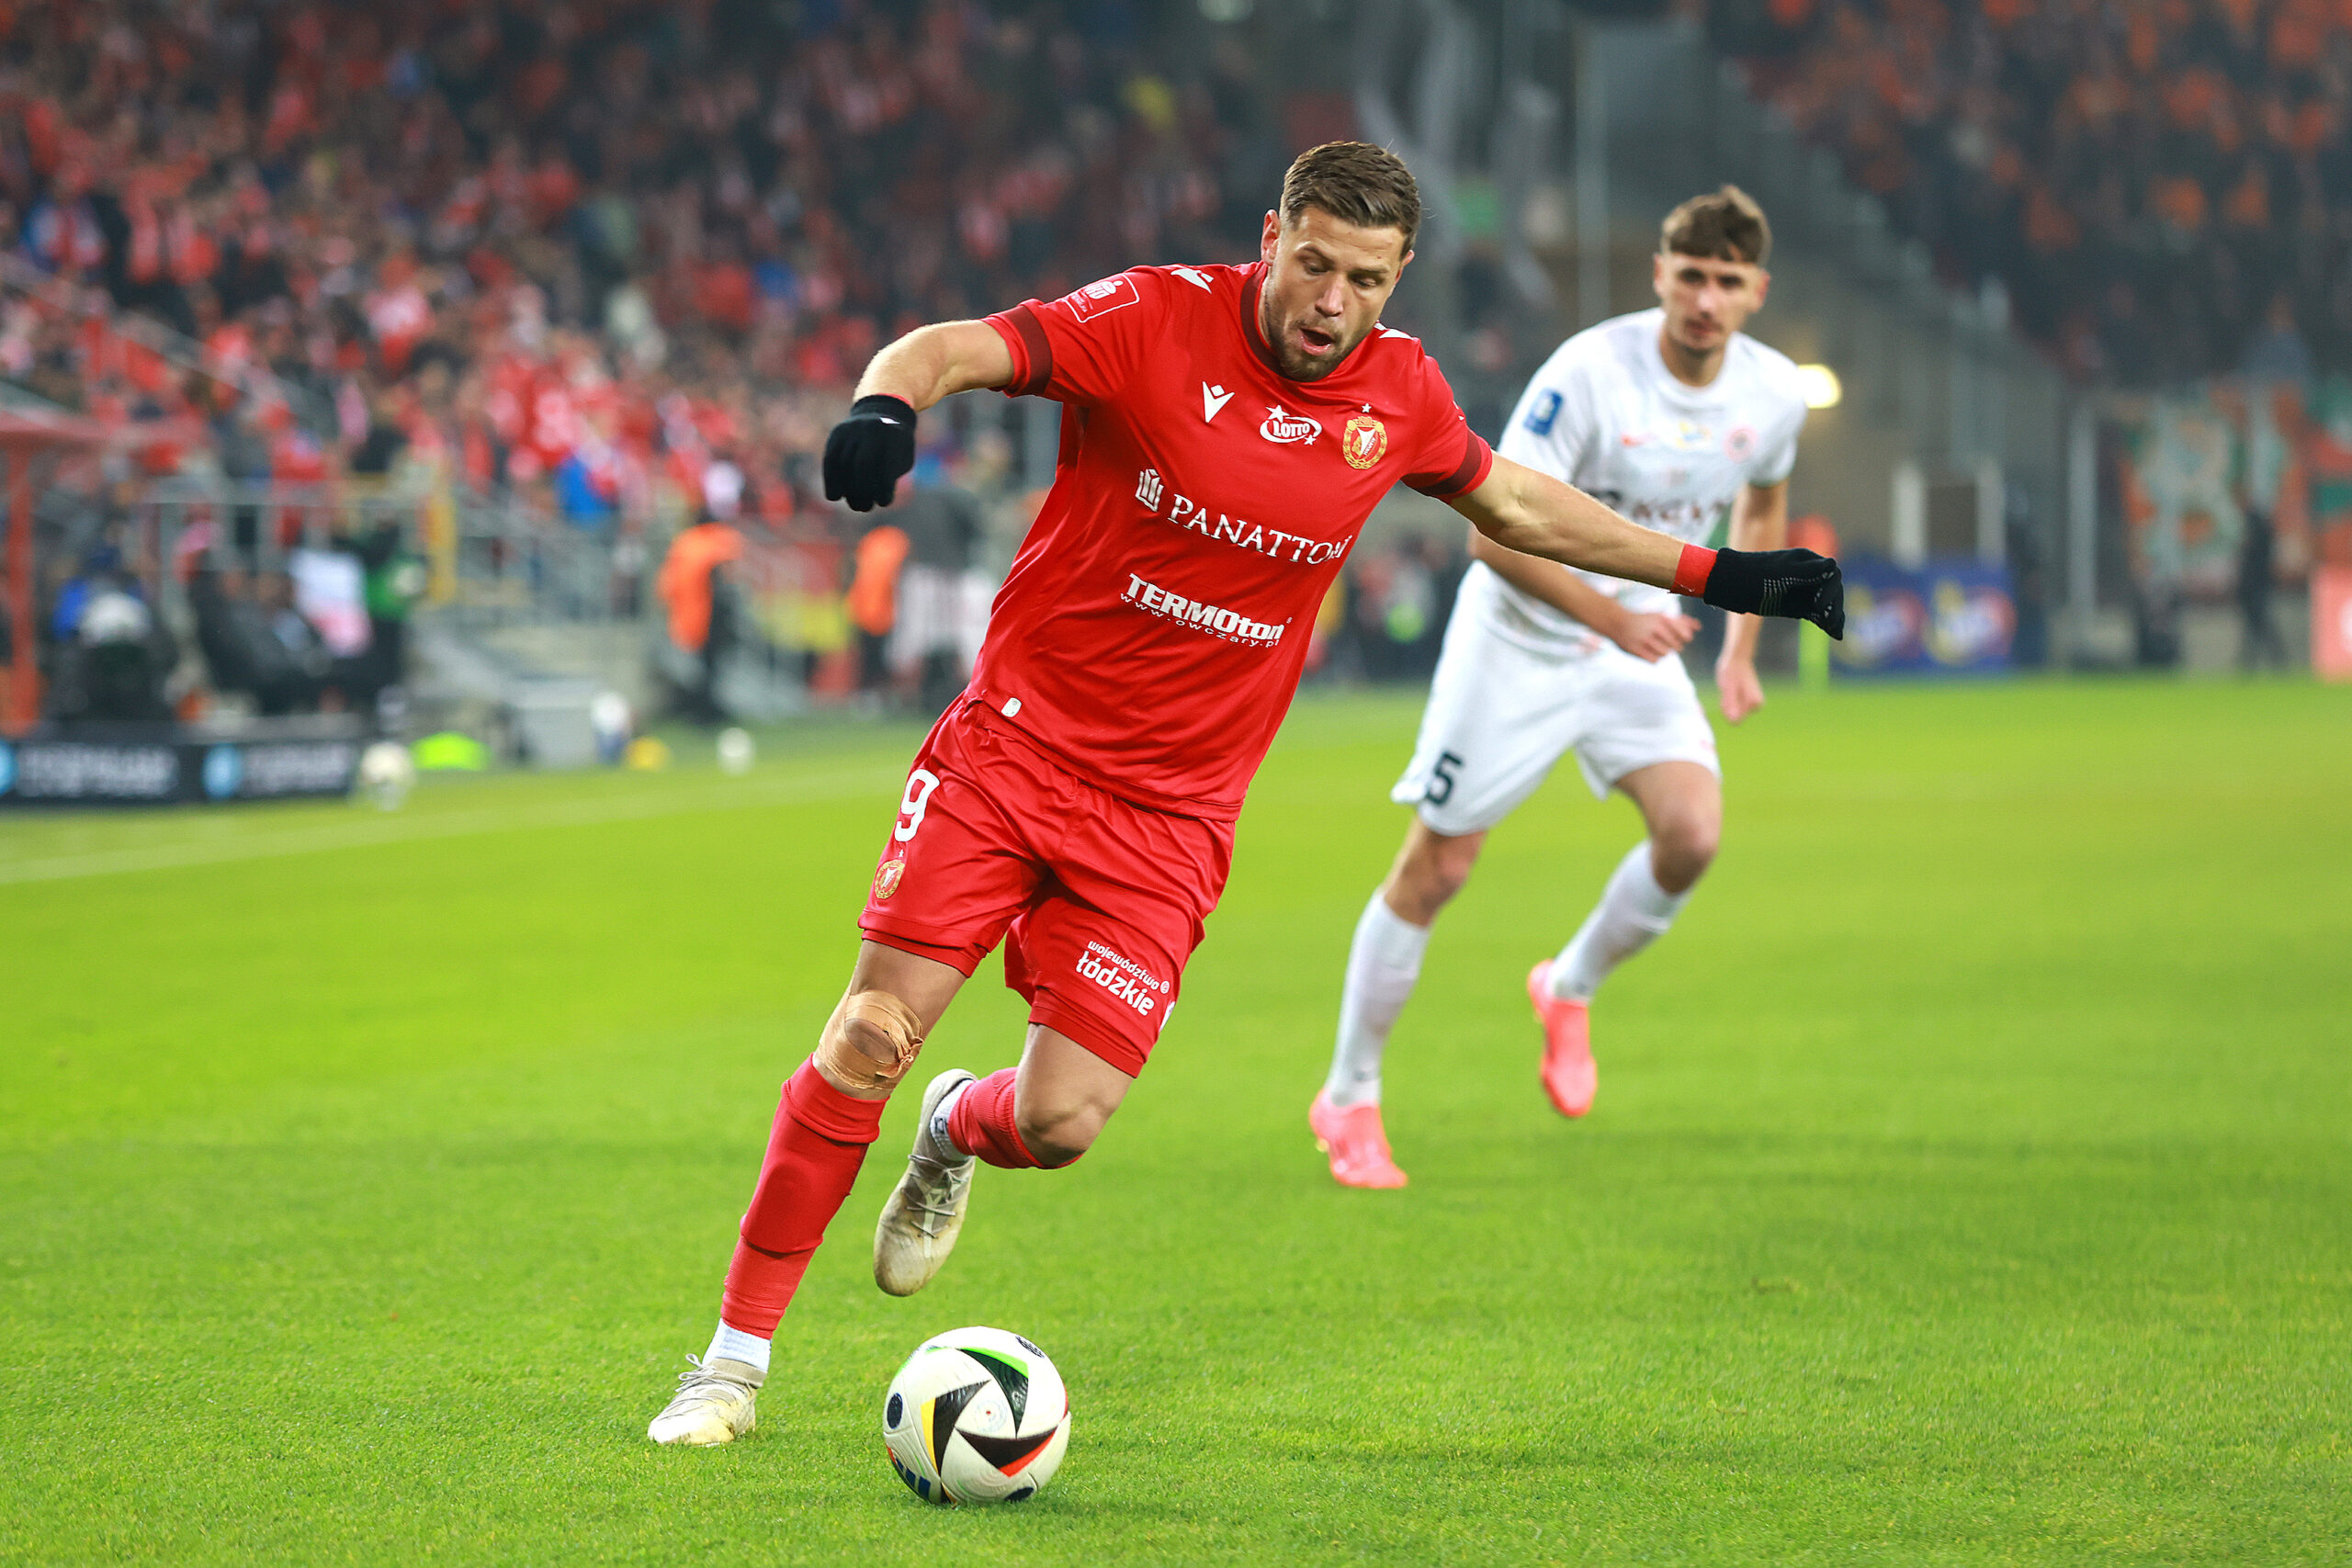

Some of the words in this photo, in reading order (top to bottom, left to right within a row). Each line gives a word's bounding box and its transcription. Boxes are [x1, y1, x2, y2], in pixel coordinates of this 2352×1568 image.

[1120, 592, 1280, 648] www.owczary.pl
[894, 768, 940, 842] 9
[1425, 751, 1463, 806] 5
[1087, 941, 1159, 990] województwo
